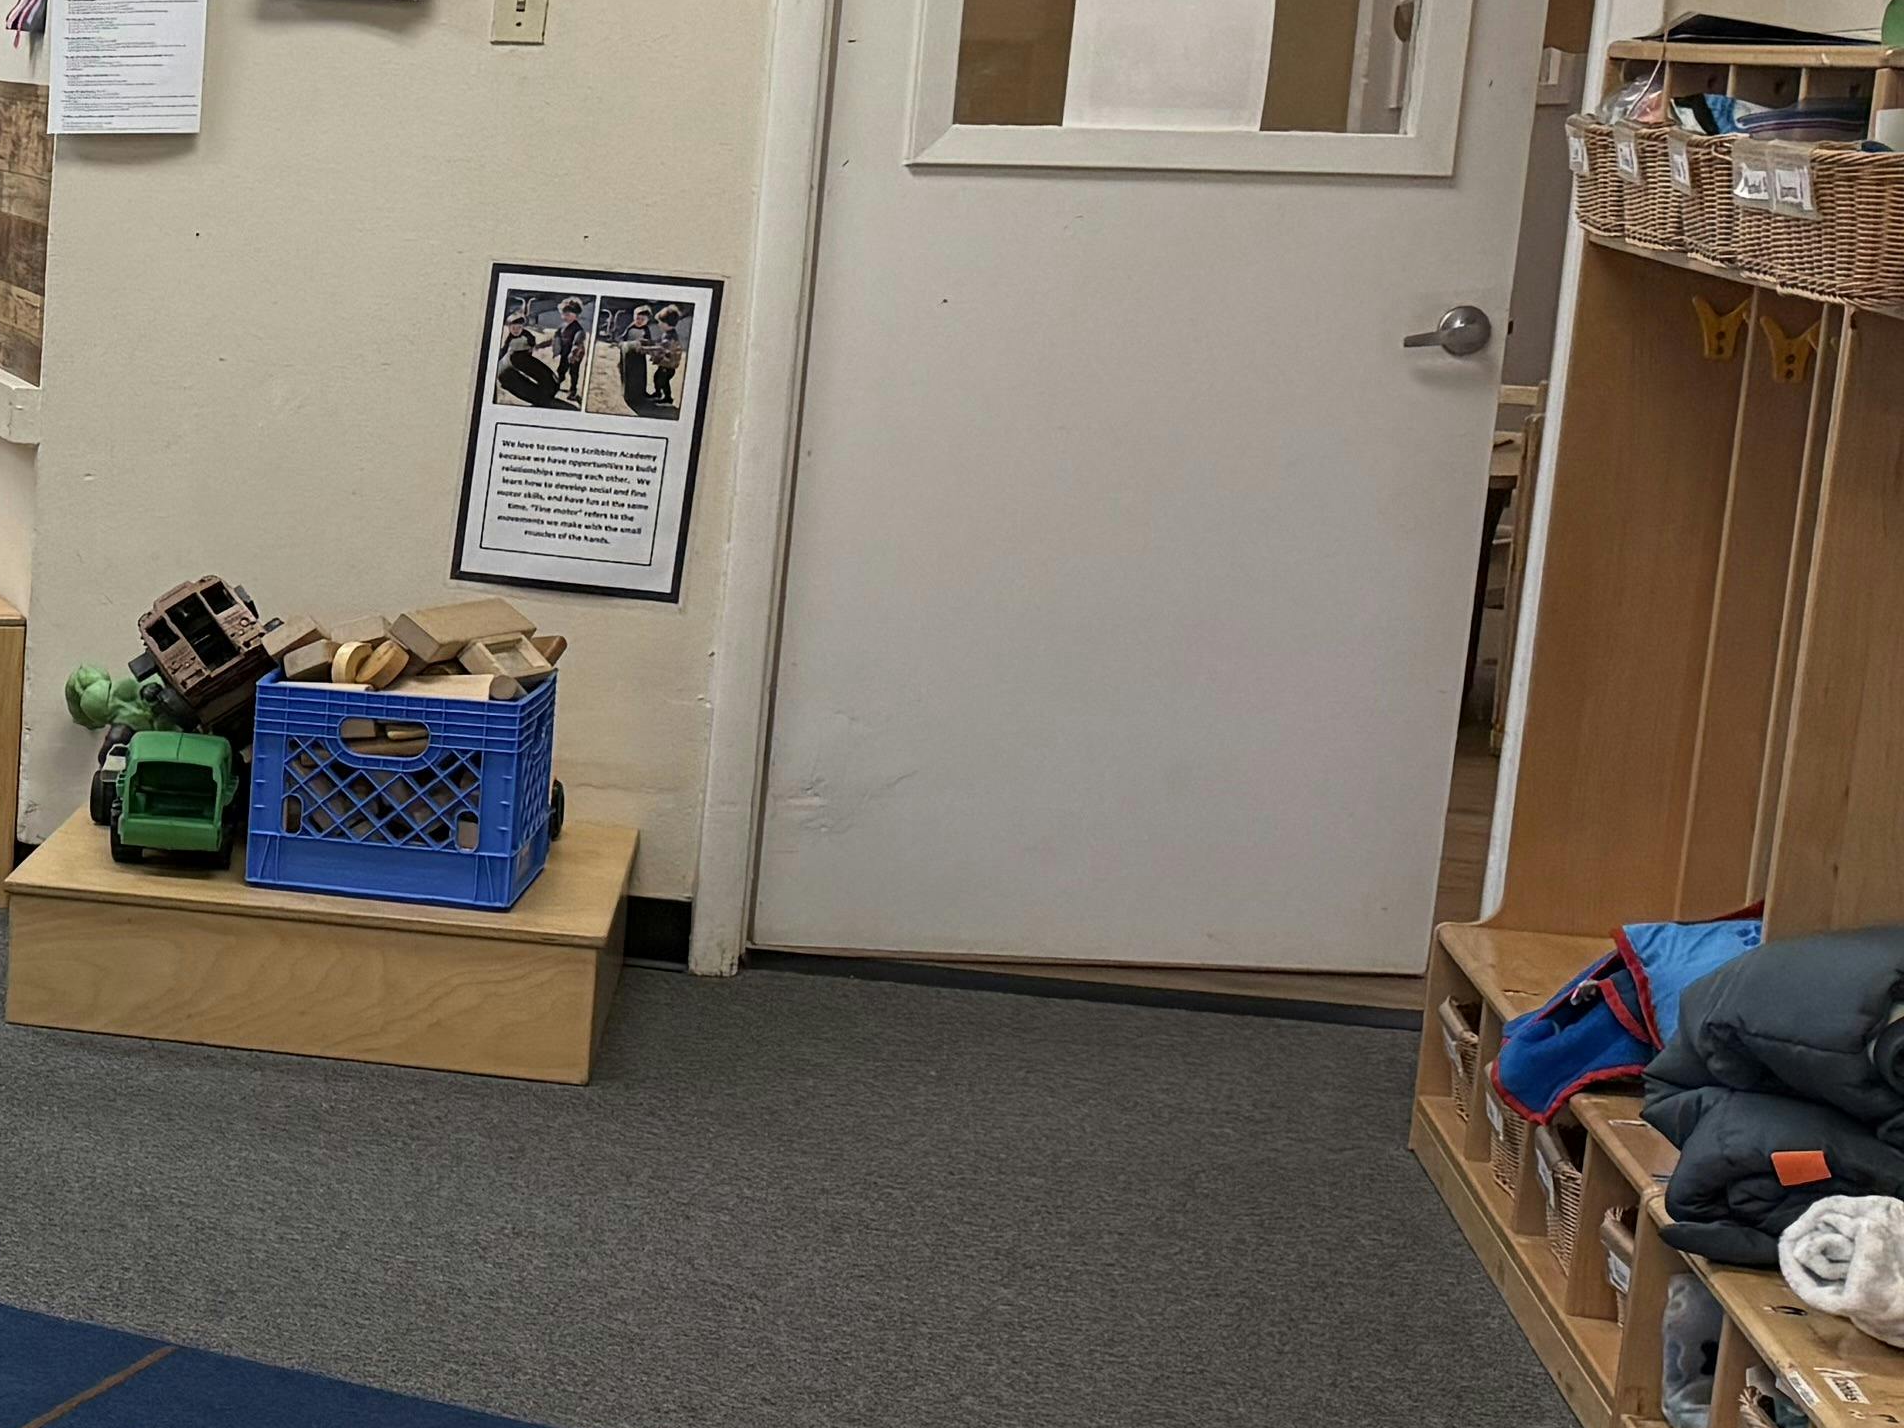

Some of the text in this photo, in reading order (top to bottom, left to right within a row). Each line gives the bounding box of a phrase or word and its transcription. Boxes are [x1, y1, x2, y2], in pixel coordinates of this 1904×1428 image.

[517, 441, 534, 449] love
[547, 445, 568, 453] come
[571, 446, 579, 454] to
[582, 448, 617, 457] Scribbles
[619, 451, 657, 461] Academy
[499, 453, 531, 461] because
[547, 457, 567, 465] have
[569, 460, 623, 470] opportunities
[636, 465, 657, 473] build
[502, 466, 553, 476] relationships
[556, 471, 582, 480] among
[502, 477, 522, 485] learn
[525, 479, 542, 487] how
[555, 482, 587, 492] develop
[590, 486, 611, 494] social
[547, 494, 562, 502] and
[564, 496, 583, 504] have
[584, 510, 607, 519] refers
[497, 515, 544, 524] movements
[561, 520, 581, 528] make
[605, 524, 618, 532] the
[620, 526, 641, 534] small
[524, 530, 556, 539] muscles
